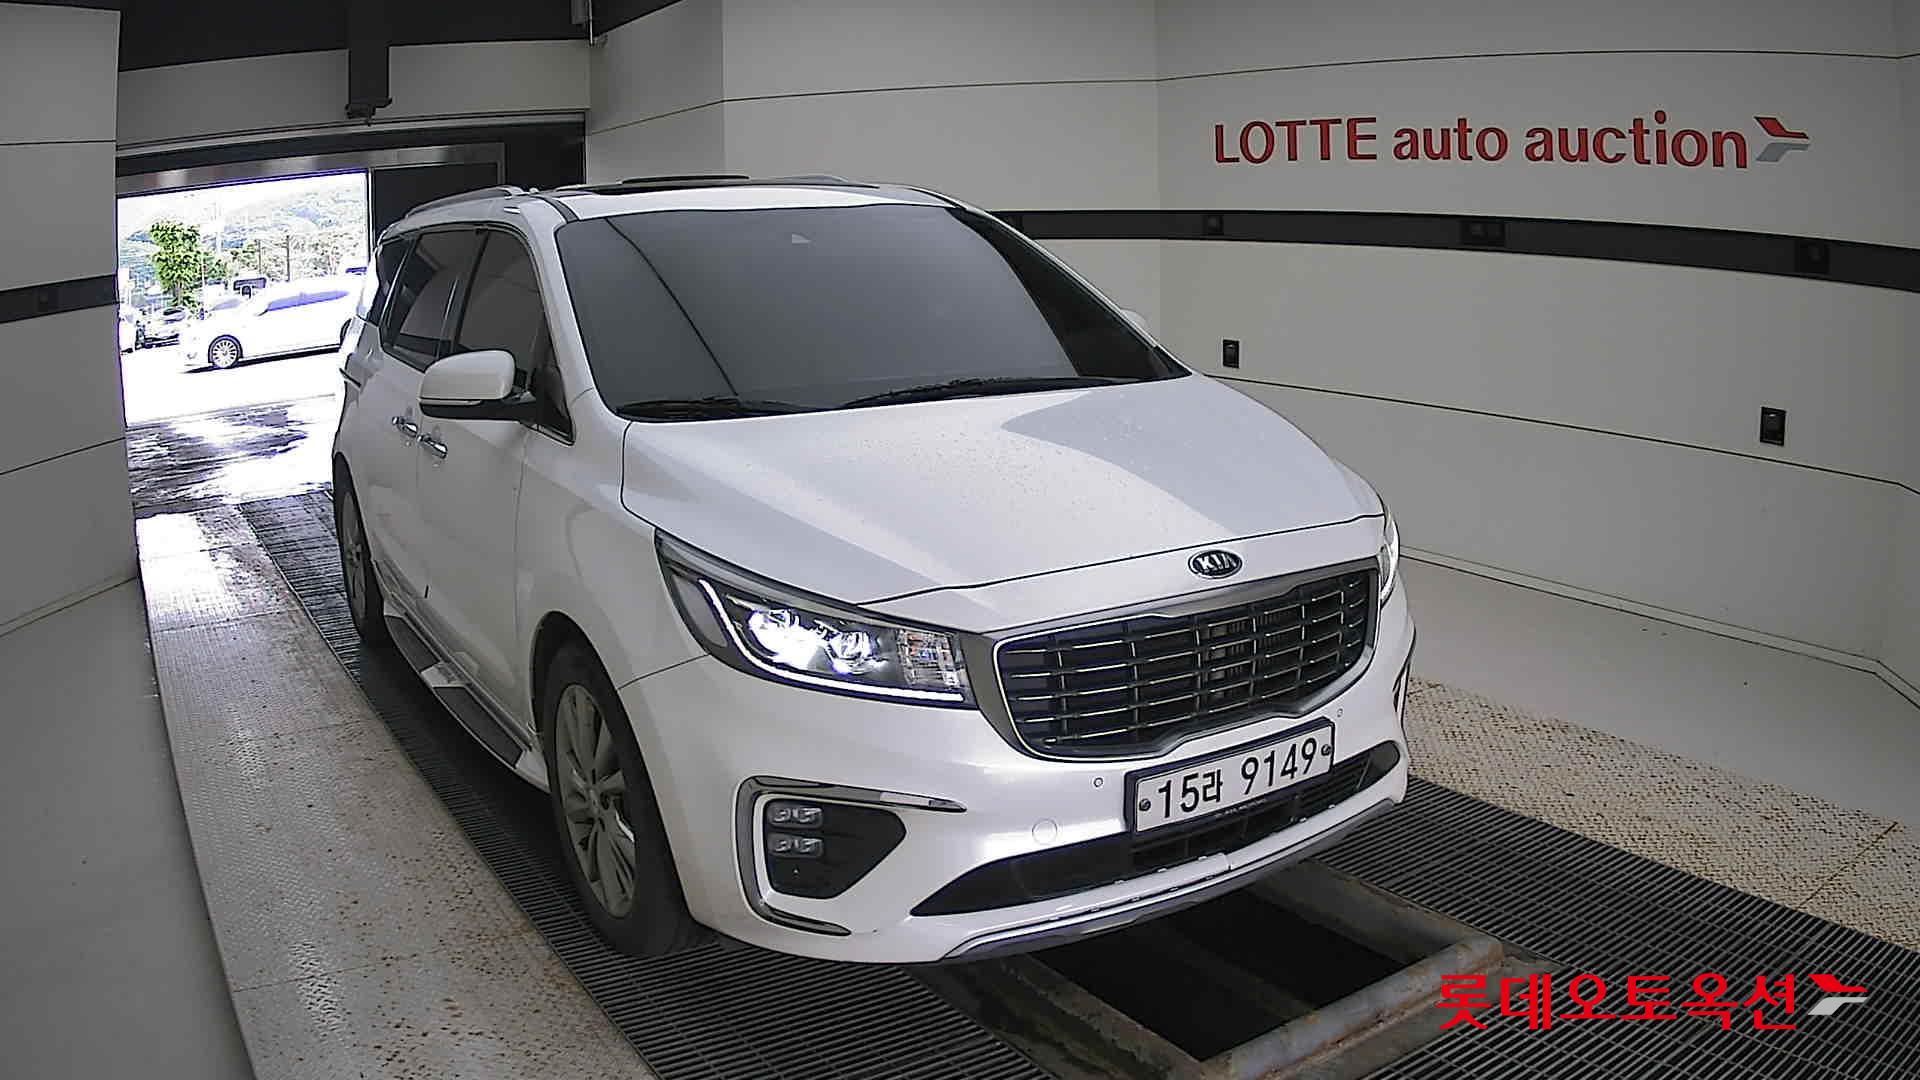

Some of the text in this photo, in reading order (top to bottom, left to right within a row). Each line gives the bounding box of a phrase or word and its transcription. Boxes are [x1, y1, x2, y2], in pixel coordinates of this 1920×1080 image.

[1215, 111, 1749, 168] LOTTE auto auction
[1196, 552, 1237, 571] KIA
[1158, 738, 1318, 818] 15라 9149
